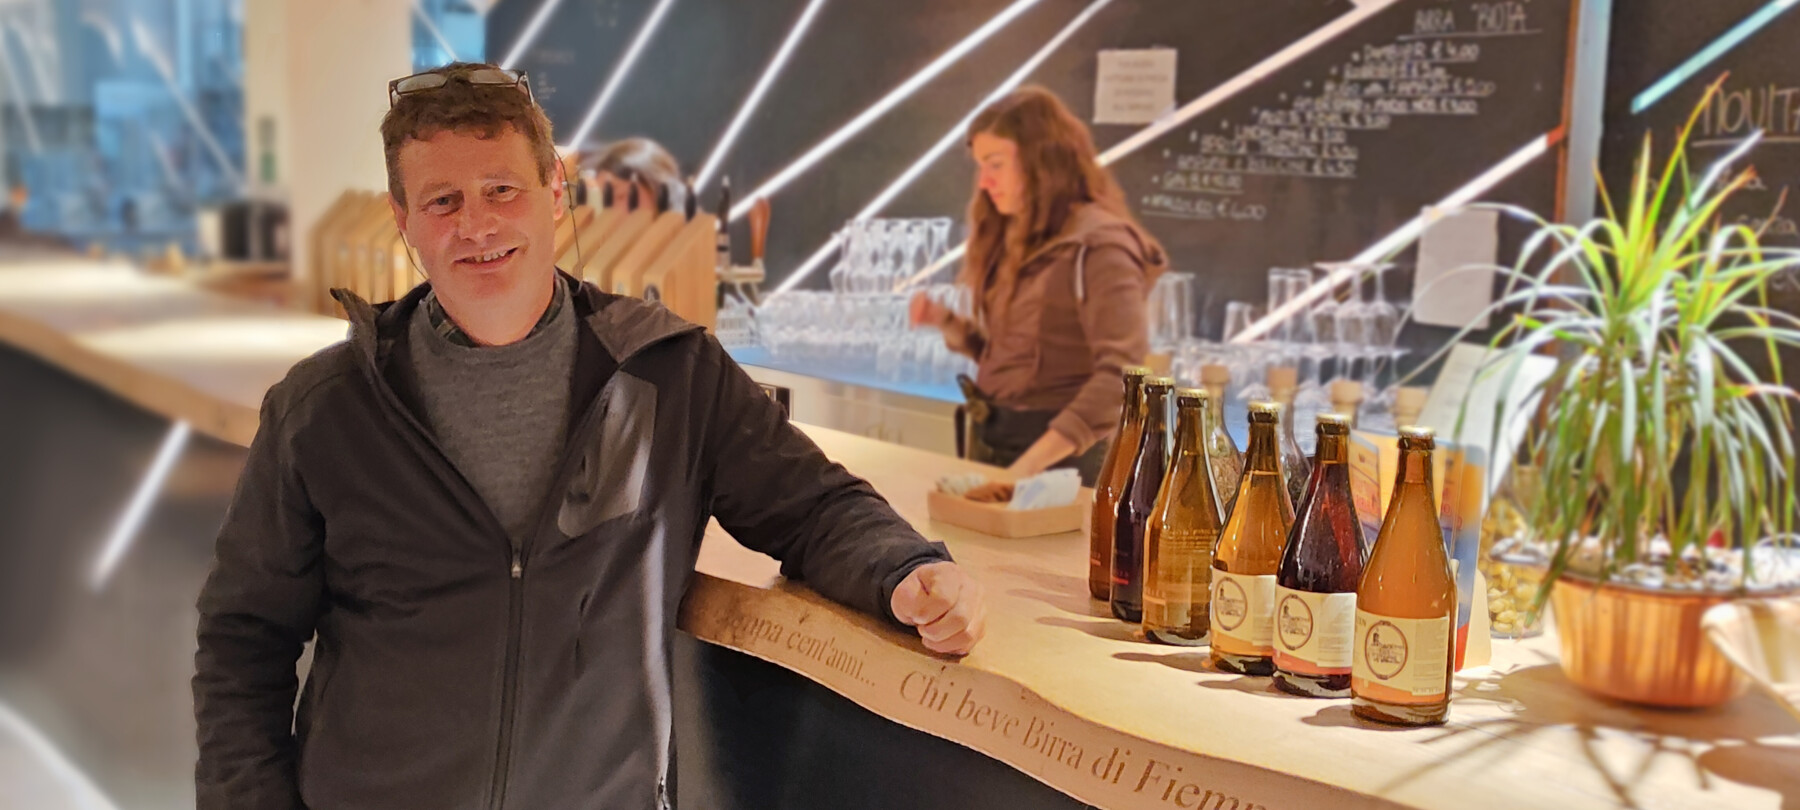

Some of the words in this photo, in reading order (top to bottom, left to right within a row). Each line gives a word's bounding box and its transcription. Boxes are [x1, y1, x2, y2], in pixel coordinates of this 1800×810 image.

[900, 670, 954, 712] Chi
[955, 688, 1020, 738] beve
[1023, 716, 1084, 770] Birra
[1091, 747, 1131, 784] di
[1133, 757, 1268, 810] Fiem
